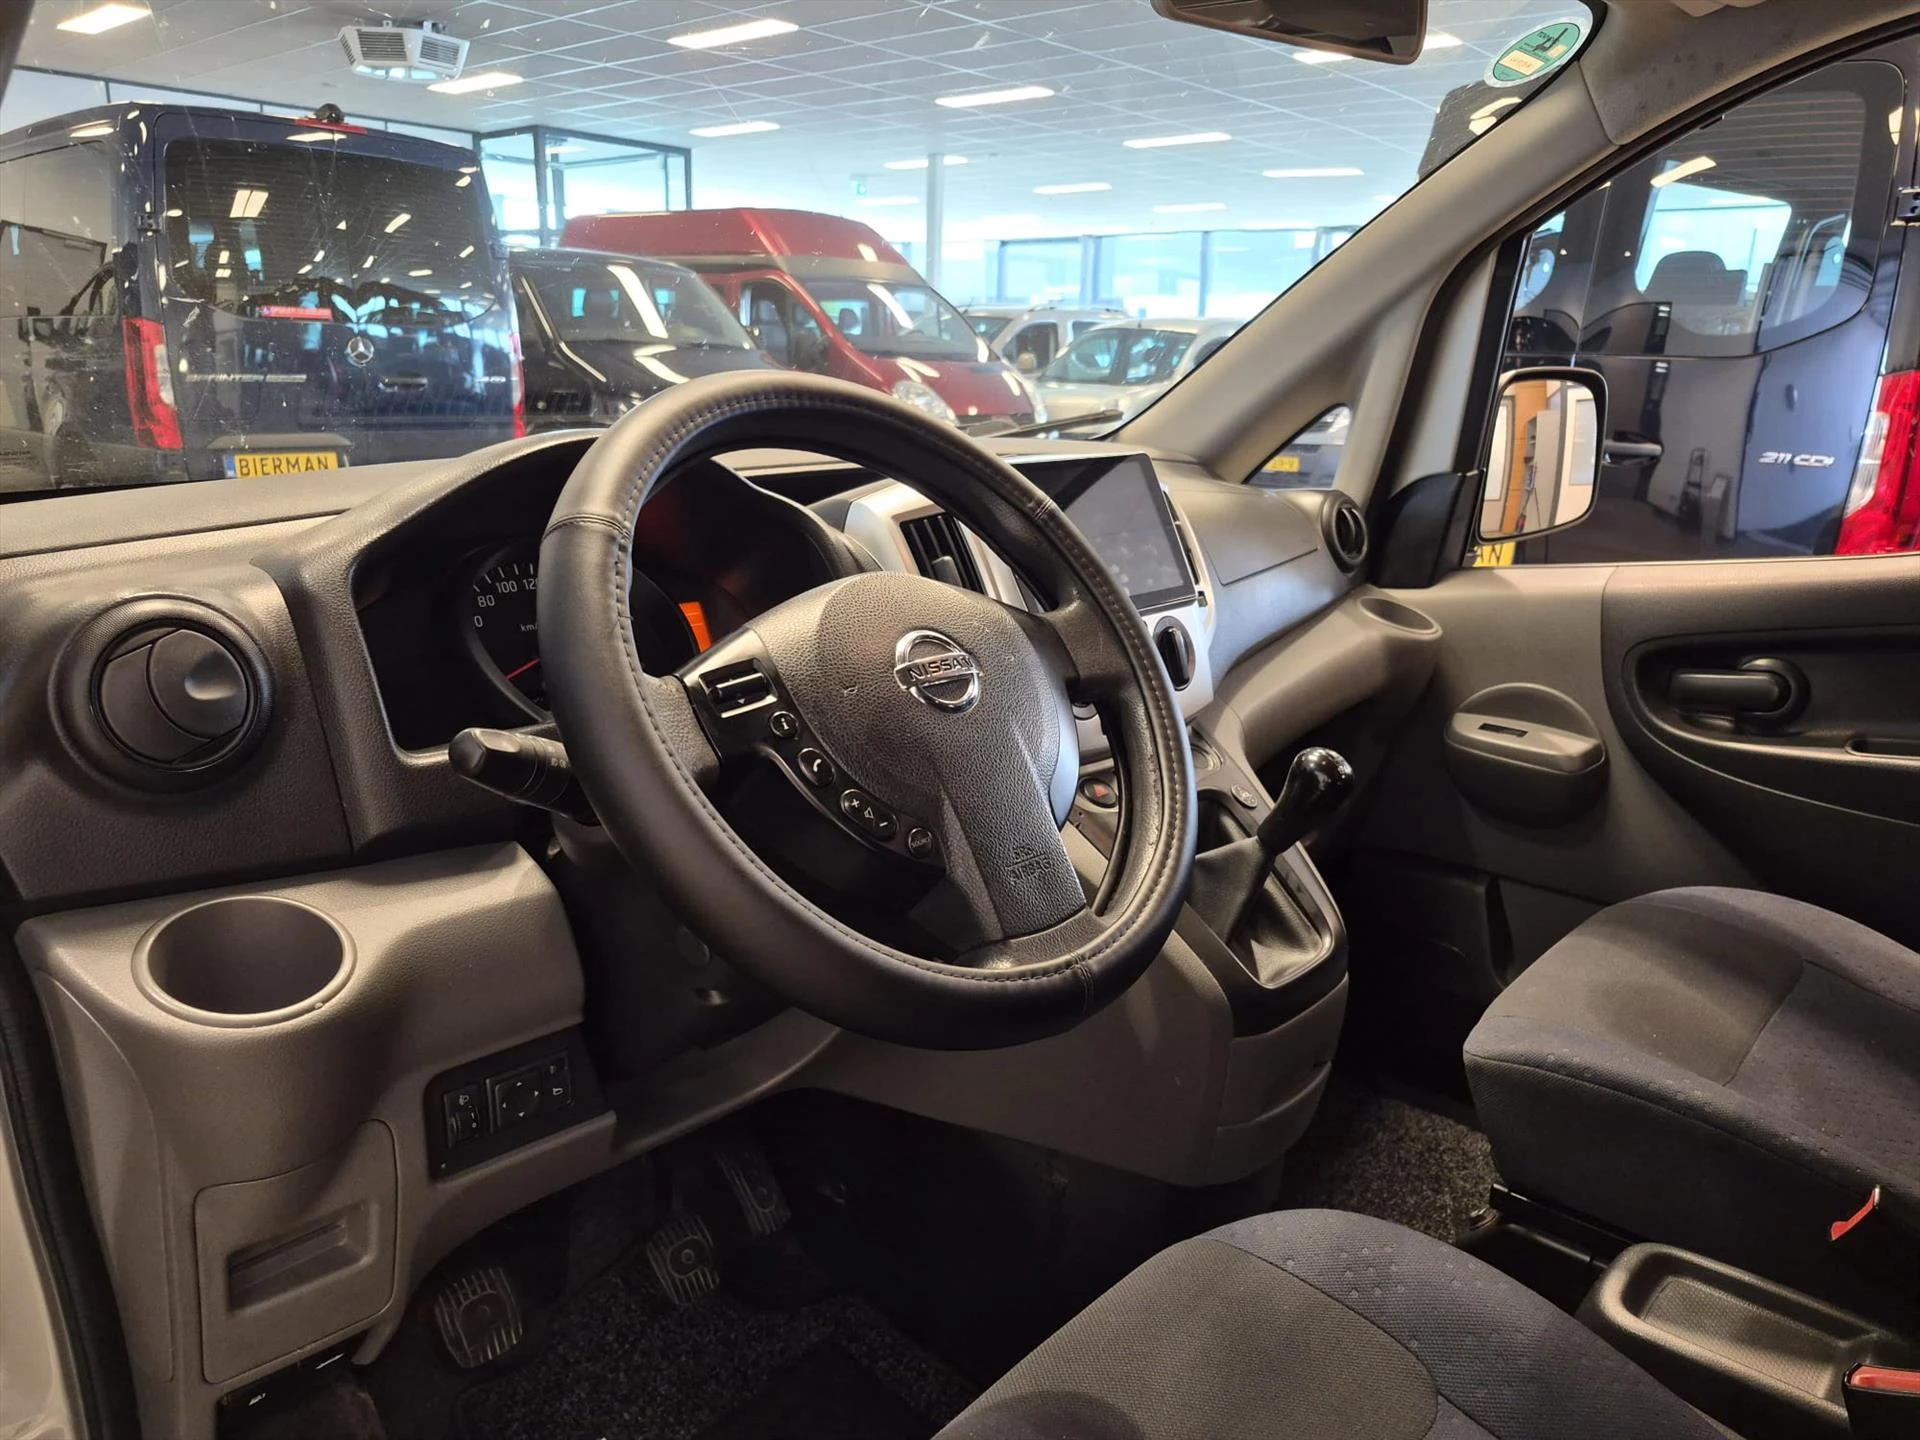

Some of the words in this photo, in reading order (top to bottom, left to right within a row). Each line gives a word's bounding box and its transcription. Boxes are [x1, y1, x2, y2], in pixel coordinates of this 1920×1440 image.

[239, 456, 329, 476] BIERMAN
[1759, 451, 1792, 464] 211
[1793, 453, 1835, 468] CDI
[496, 580, 518, 593] 100
[523, 578, 537, 590] 12
[477, 594, 495, 608] 80
[906, 656, 974, 680] NISSAN
